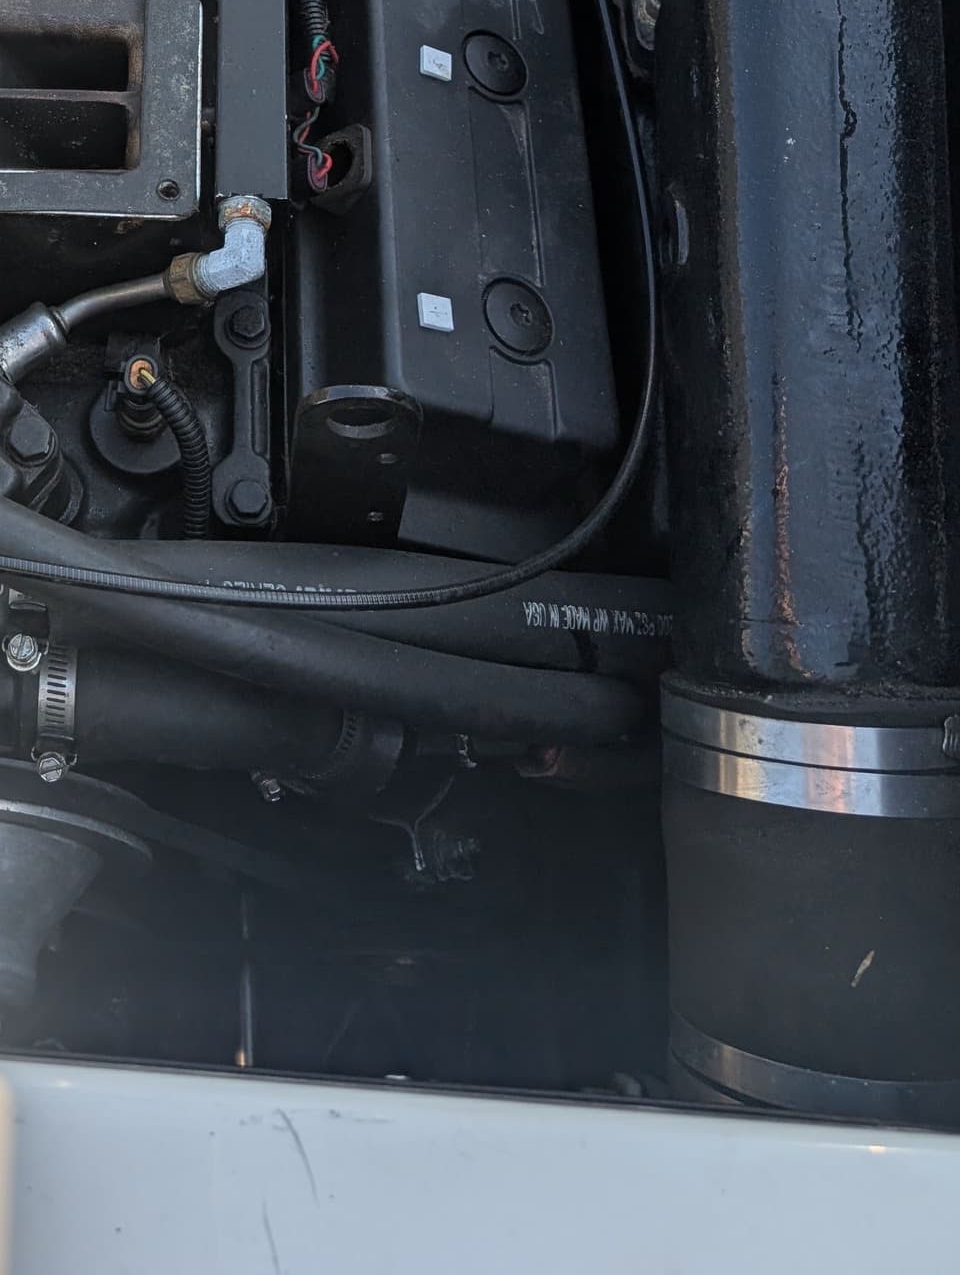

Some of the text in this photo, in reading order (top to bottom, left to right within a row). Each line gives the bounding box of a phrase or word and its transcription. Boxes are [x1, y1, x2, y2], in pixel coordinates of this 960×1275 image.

[522, 601, 547, 627] USA
[548, 603, 560, 630] IN
[560, 604, 591, 631] MADE
